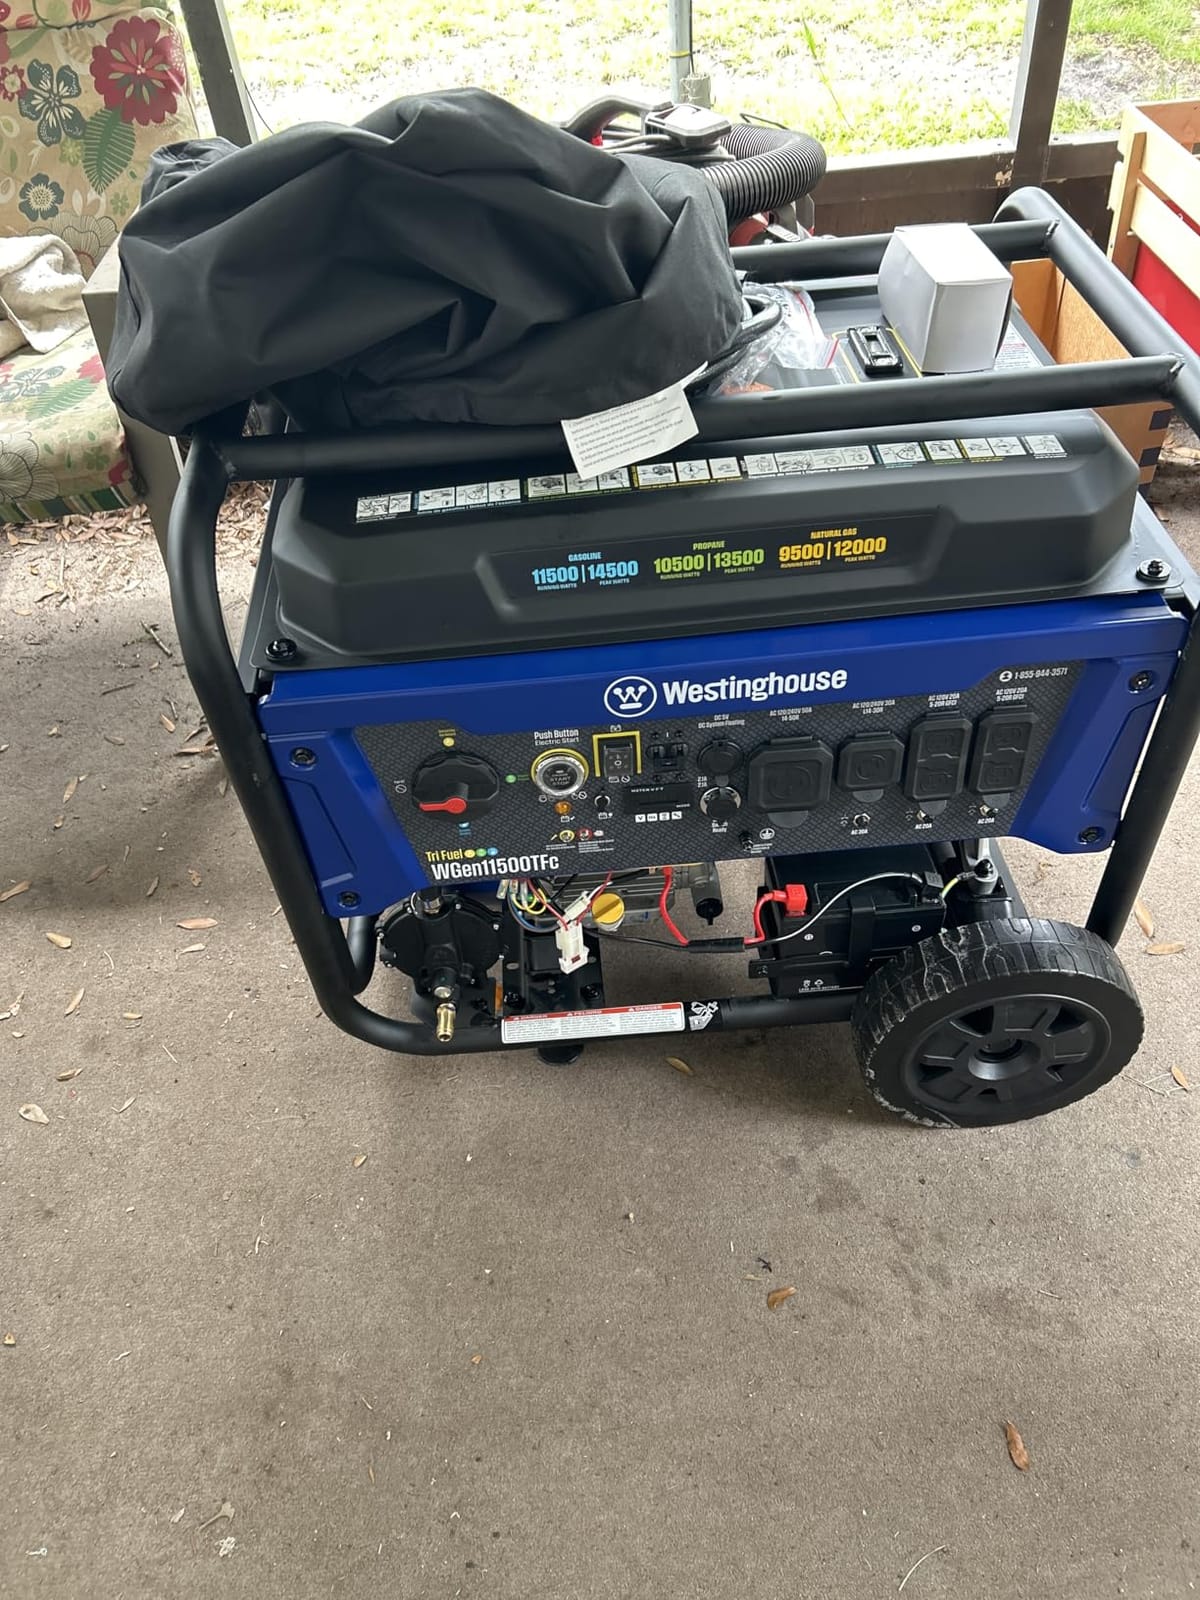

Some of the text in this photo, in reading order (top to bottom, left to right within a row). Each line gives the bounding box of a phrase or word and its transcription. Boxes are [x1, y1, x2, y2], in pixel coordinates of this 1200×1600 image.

[810, 527, 858, 540] NATURAL GAS
[692, 540, 725, 551] PROPANE
[779, 536, 887, 562] 9500 12000
[568, 552, 602, 562] GASOLINE
[654, 548, 765, 574] 10500 13500
[532, 560, 639, 585] 11500 14500
[1014, 667, 1068, 680] 1-855-944-3571
[662, 669, 848, 706] Westinghouse
[533, 729, 579, 740] Push Button
[534, 738, 561, 746] Electric
[425, 848, 464, 862] Tri Fuel
[431, 854, 560, 880] WGen11500TFc
